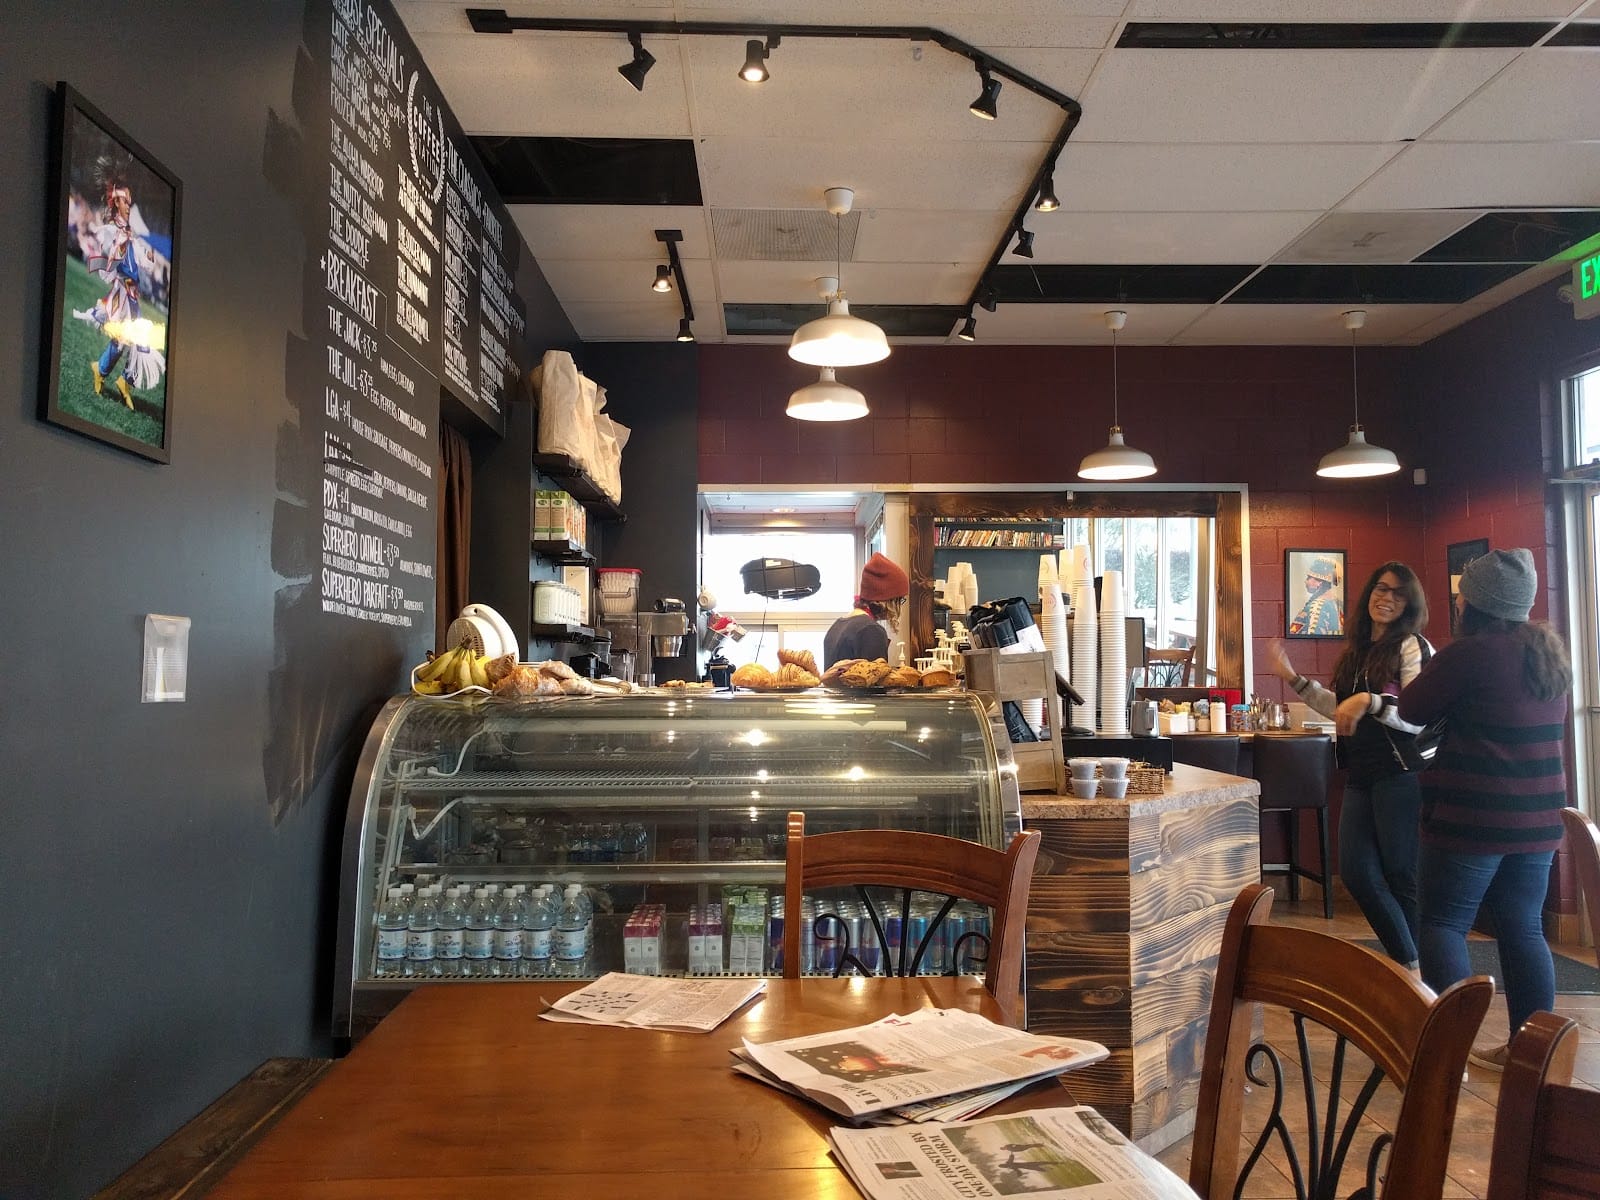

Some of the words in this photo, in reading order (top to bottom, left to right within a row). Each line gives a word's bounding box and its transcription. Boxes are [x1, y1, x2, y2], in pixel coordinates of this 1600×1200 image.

[365, 5, 405, 93] SPECIALS
[331, 62, 350, 99] WHITE
[330, 118, 342, 149] THE
[413, 105, 441, 163] COFFEE
[414, 131, 440, 182] STATION
[330, 163, 342, 194] THE
[343, 179, 361, 212] NUTTY
[362, 201, 388, 242] IRISHMAN
[329, 203, 343, 236] THE
[346, 221, 369, 261] DOODLE
[327, 249, 377, 325] BREAKFAST
[328, 305, 343, 337] THE
[344, 318, 361, 353] JACK
[327, 346, 342, 379] THE
[342, 357, 357, 390] JILL
[326, 387, 339, 420] LGA
[324, 479, 338, 509] PDX
[323, 524, 358, 558] SUPERHERO
[360, 534, 384, 565] OATMEAL
[322, 569, 361, 604] SUPERHERO
[363, 581, 388, 609] PARFAIT
[909, 1131, 924, 1144] BY
[928, 1135, 960, 1164] STORM
[920, 1144, 956, 1179] FROSTED
[951, 1181, 976, 1199] CITY
[955, 1165, 992, 1199] ONE-DAY
